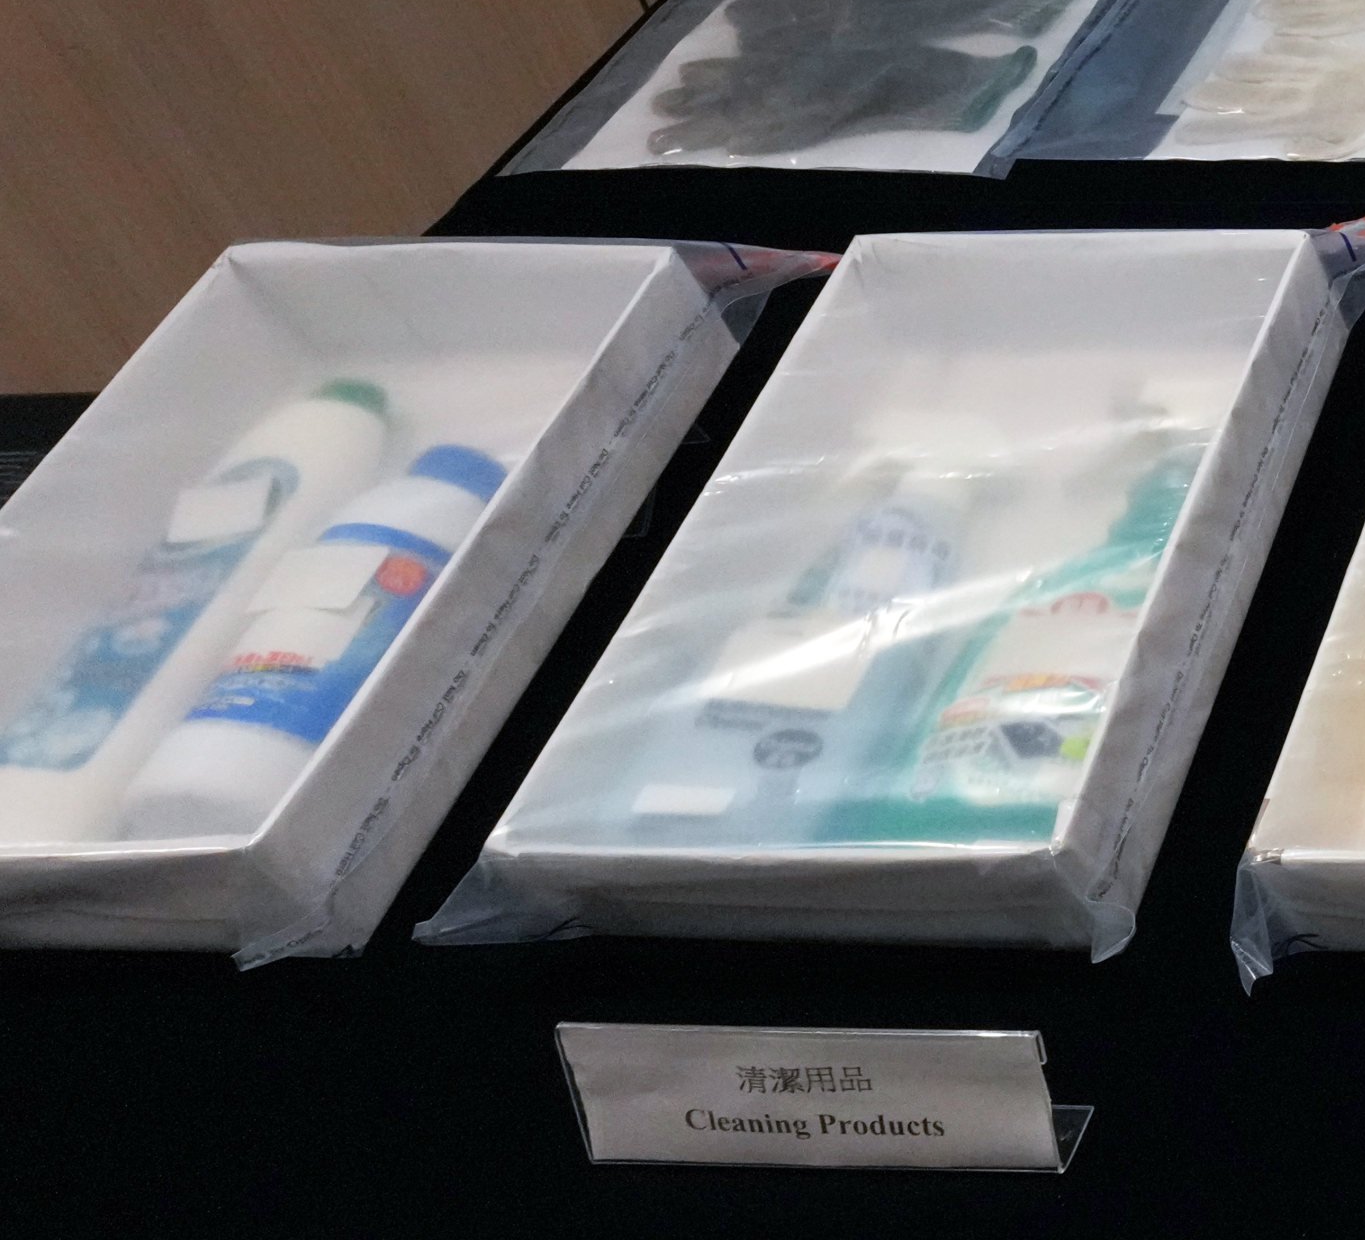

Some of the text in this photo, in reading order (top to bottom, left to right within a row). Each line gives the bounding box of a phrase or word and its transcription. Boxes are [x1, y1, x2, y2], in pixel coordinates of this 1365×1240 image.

[737, 1066, 872, 1094] 清潔用品
[685, 1109, 945, 1140] Cleaning Products
